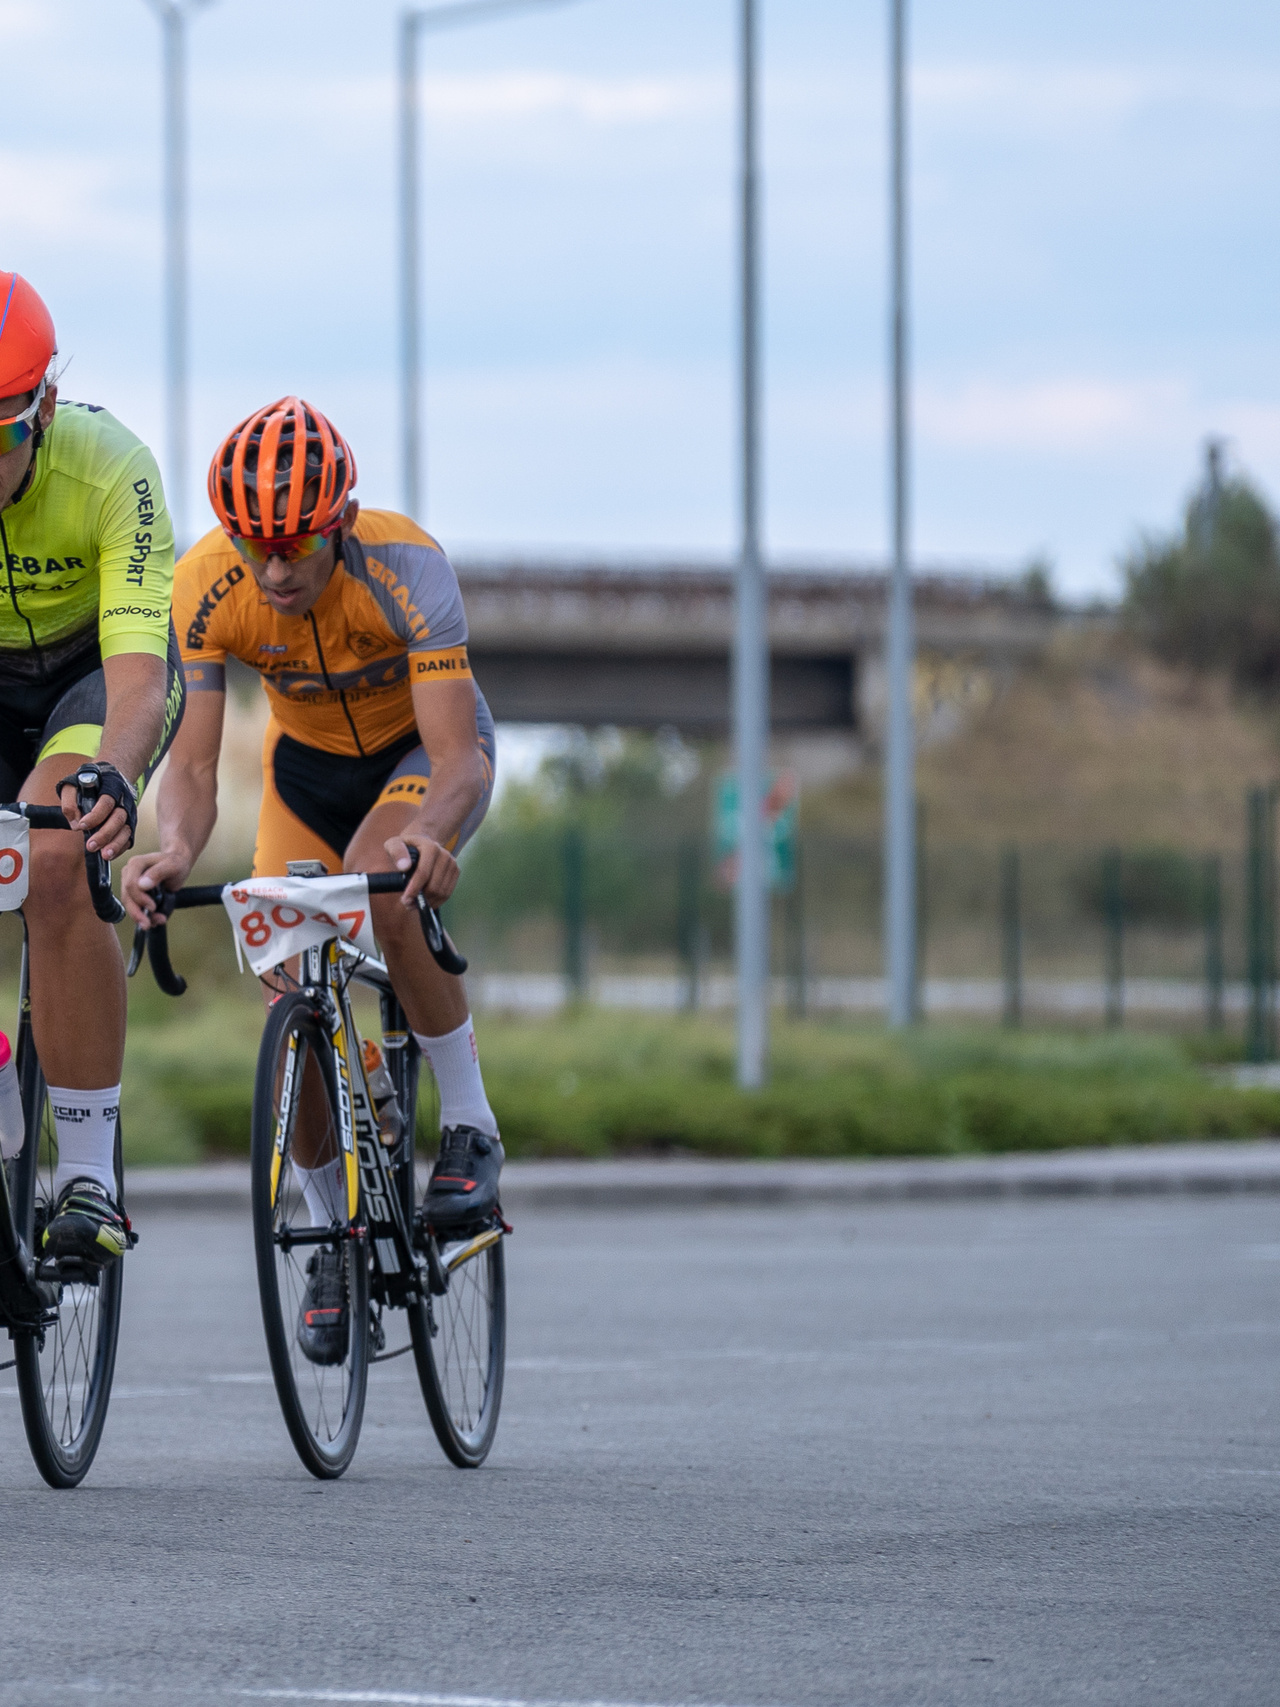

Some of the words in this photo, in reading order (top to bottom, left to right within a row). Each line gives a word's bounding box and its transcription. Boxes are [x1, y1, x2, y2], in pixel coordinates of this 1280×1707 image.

[101, 605, 162, 622] prologo
[416, 658, 457, 673] DANI
[275, 1047, 296, 1153] SCOTT
[334, 1047, 354, 1153] SCOTT
[72, 1181, 108, 1200] SIDI
